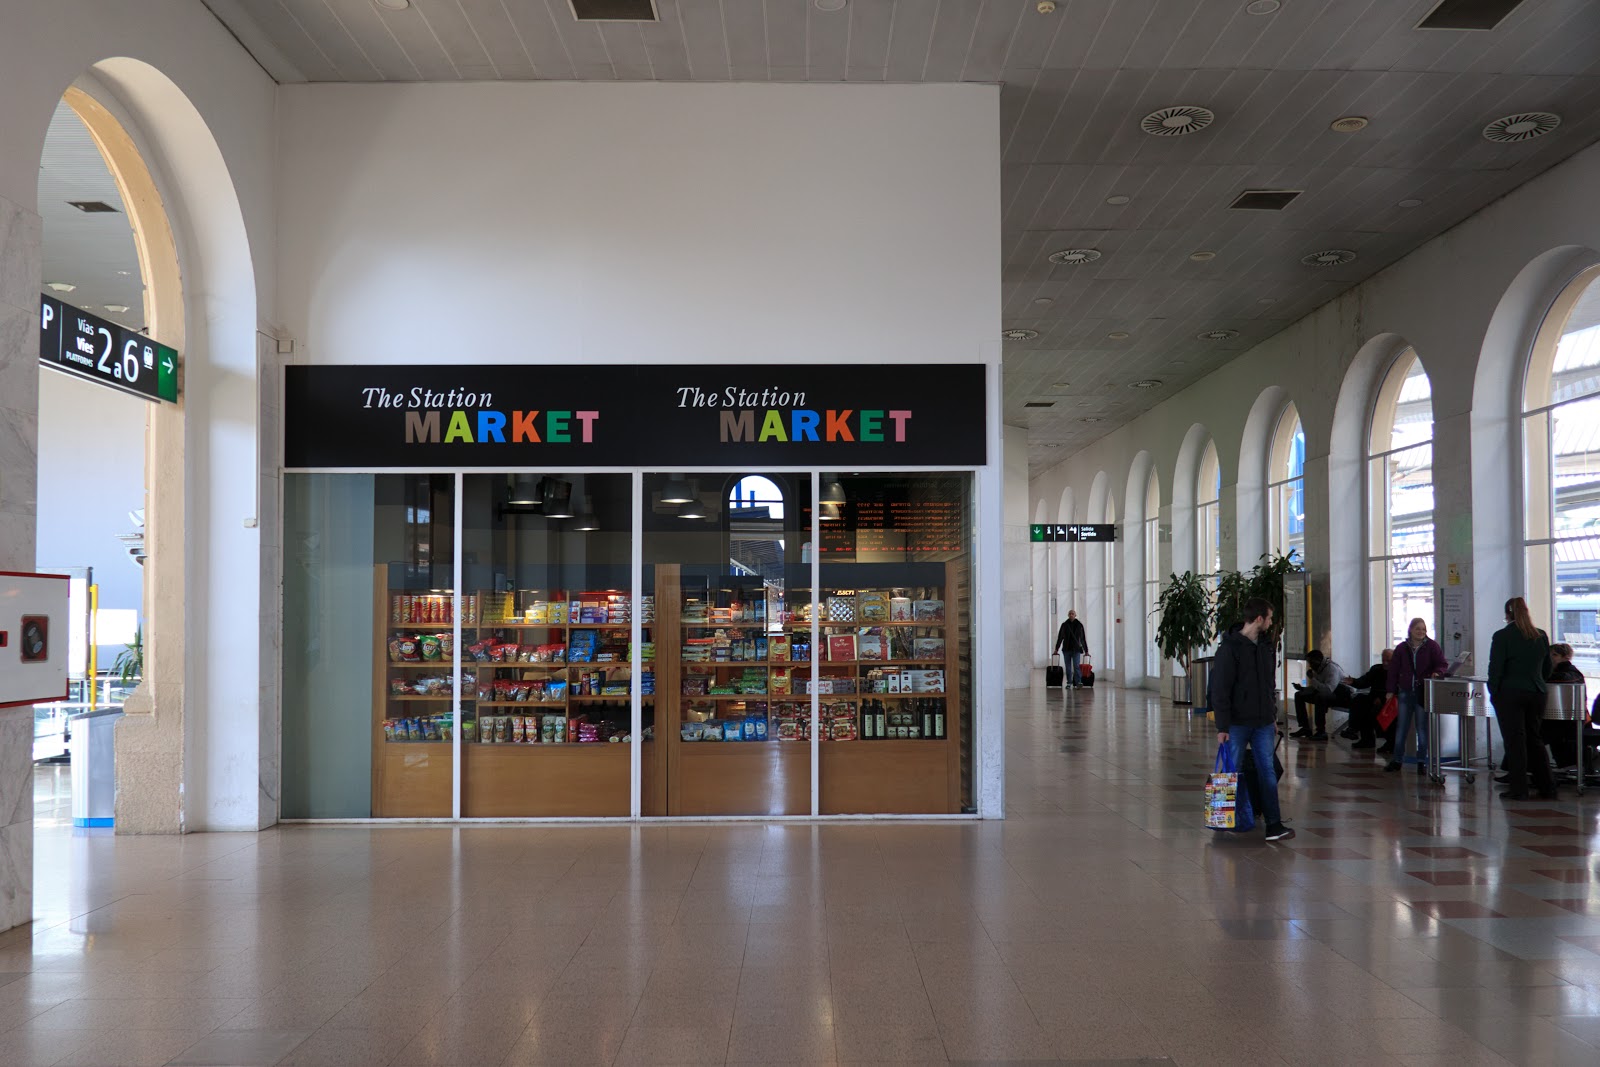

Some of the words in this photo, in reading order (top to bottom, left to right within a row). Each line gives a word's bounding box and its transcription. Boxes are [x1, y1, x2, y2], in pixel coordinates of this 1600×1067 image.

[42, 304, 54, 329] P
[77, 317, 94, 335] Vías
[76, 336, 94, 355] Vies
[66, 350, 94, 368] PLATFORMS
[362, 387, 404, 408] The
[408, 386, 492, 408] Station
[676, 386, 718, 408] The
[722, 386, 806, 407] Station
[405, 410, 600, 443] MARKET
[719, 409, 912, 443] MARKET
[1451, 688, 1482, 701] renfe
